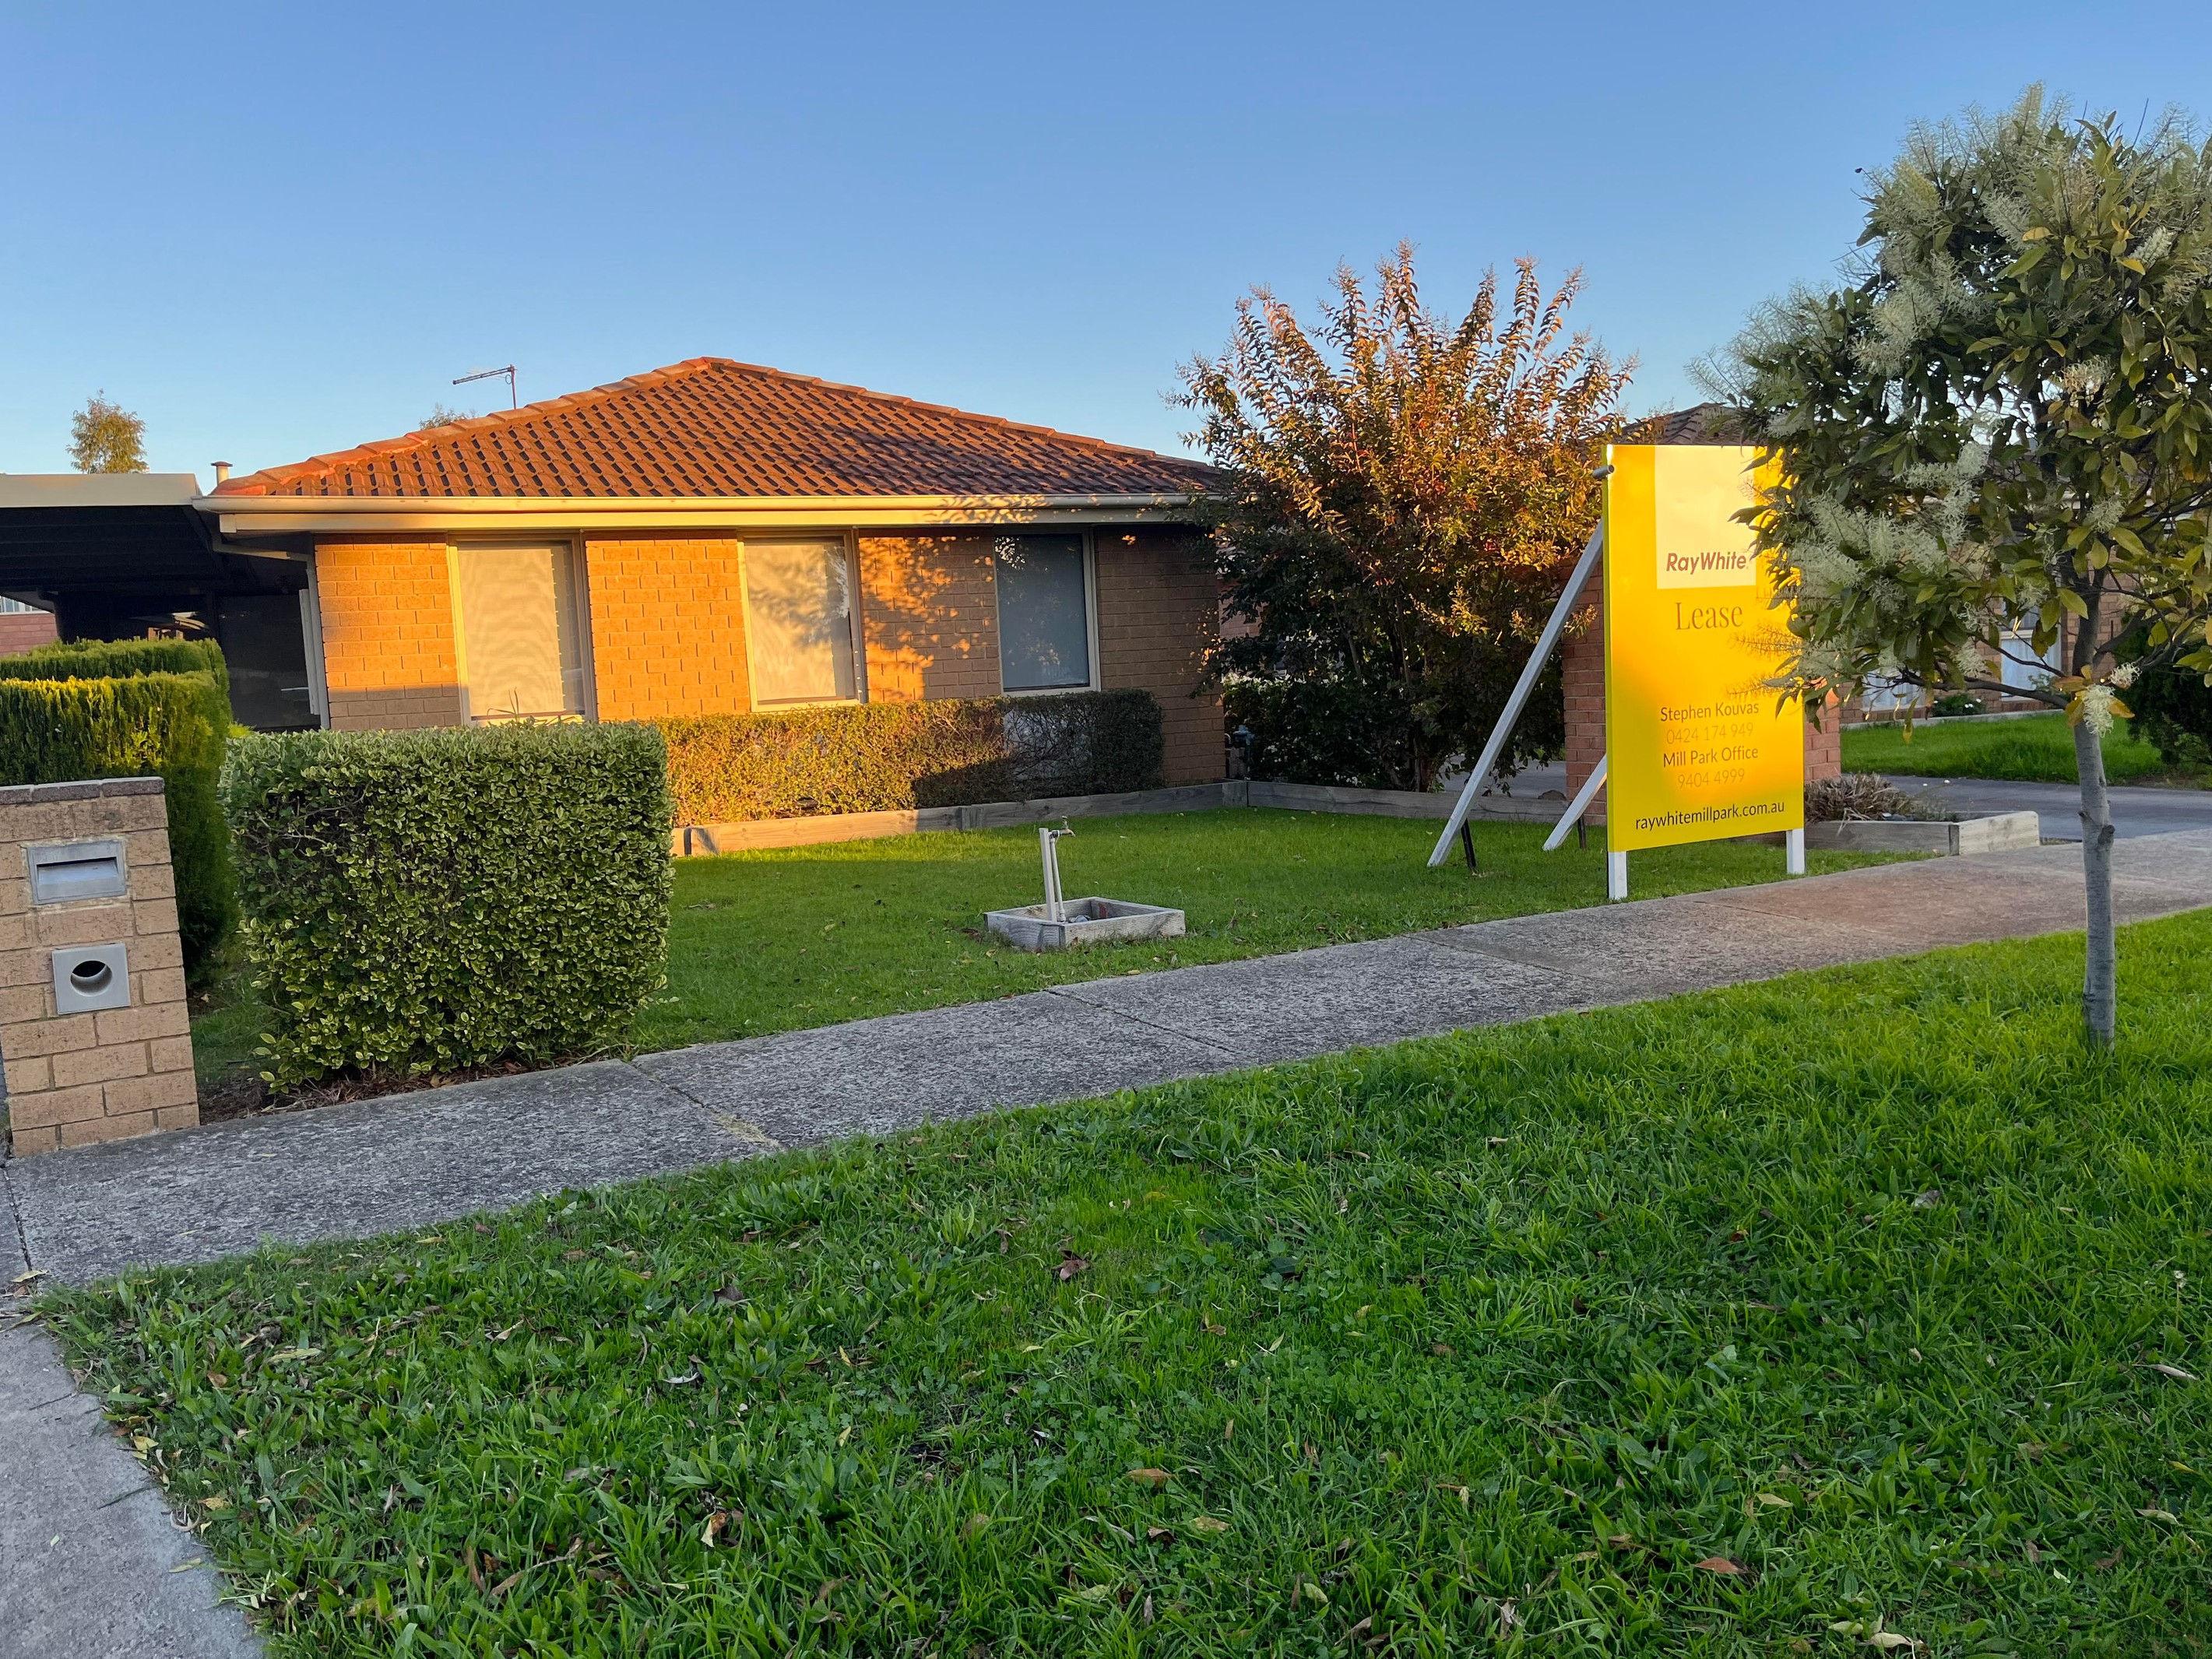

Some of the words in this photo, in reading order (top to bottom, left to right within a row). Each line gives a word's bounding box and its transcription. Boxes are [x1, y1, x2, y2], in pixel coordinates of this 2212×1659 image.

[1676, 601, 1743, 631] Lease
[1660, 705, 1711, 723] Stephen
[1715, 701, 1760, 717] Kouvas
[1666, 727, 1699, 745] 0424
[1704, 725, 1727, 740] 174
[1732, 722, 1754, 737] 949
[1663, 752, 1686, 768] Mill
[1690, 748, 1718, 765] Park
[1721, 745, 1759, 762] Office
[1677, 771, 1710, 789] 9404
[1714, 768, 1745, 785] 4999
[1636, 801, 1785, 831] raywhitemillpark.com.au
